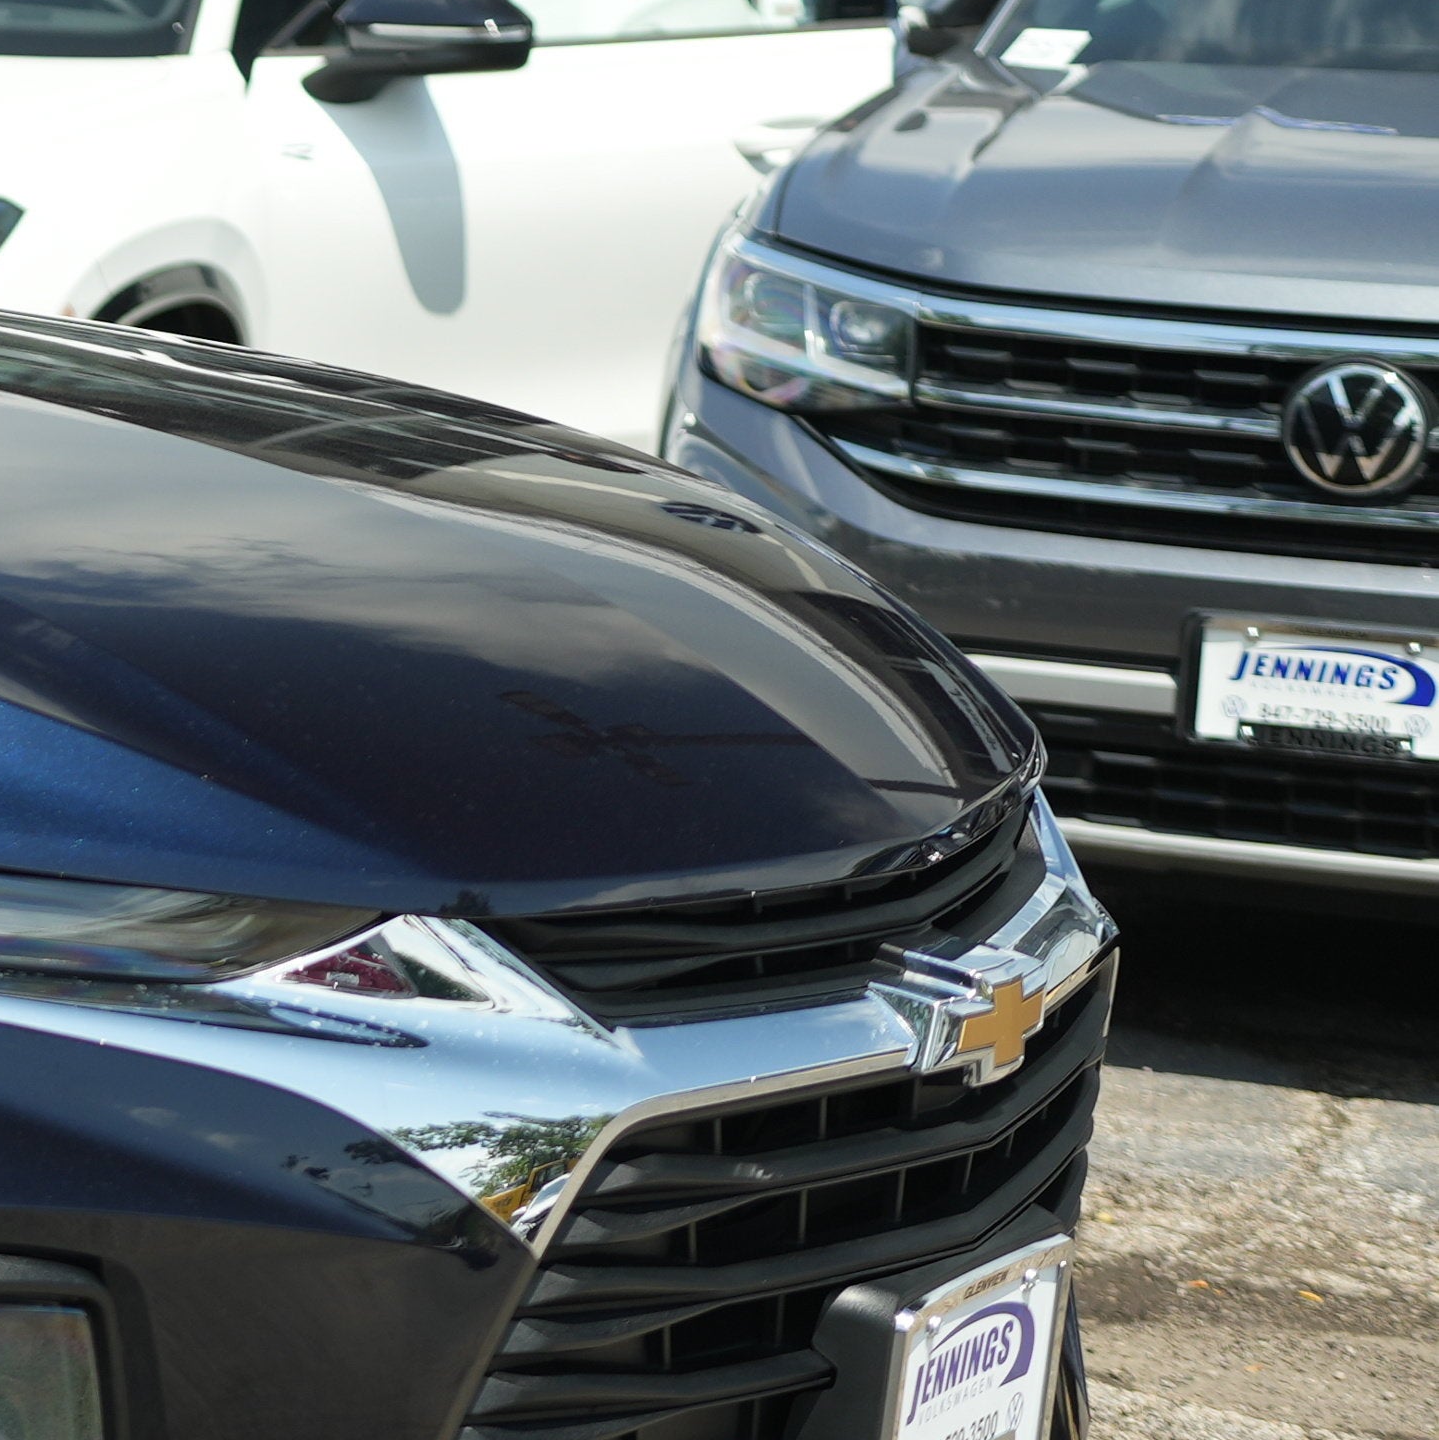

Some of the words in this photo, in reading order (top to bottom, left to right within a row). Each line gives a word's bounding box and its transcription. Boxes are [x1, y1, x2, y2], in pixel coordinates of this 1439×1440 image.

[1230, 651, 1399, 690] JENNINGS
[906, 1319, 1015, 1427] JENNINGS
[917, 1375, 994, 1426] VOLKSWAGEN
